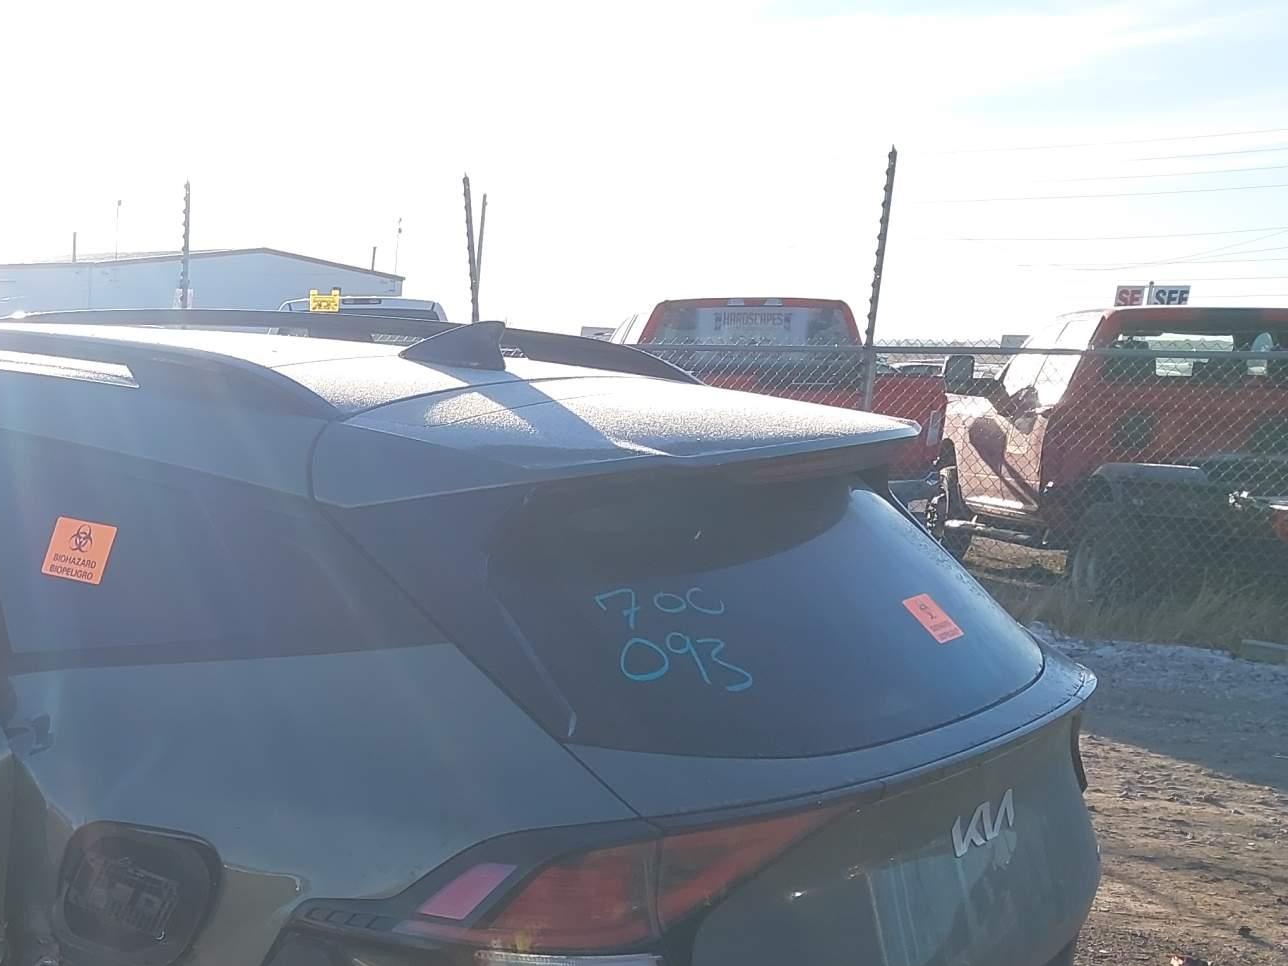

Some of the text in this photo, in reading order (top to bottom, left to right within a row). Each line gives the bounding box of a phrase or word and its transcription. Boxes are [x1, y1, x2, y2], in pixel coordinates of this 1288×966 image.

[49, 564, 94, 580] BIOPELIGRO
[53, 553, 97, 568] BIOHAZARD
[619, 631, 754, 693] 093
[950, 788, 1017, 859] KIA
